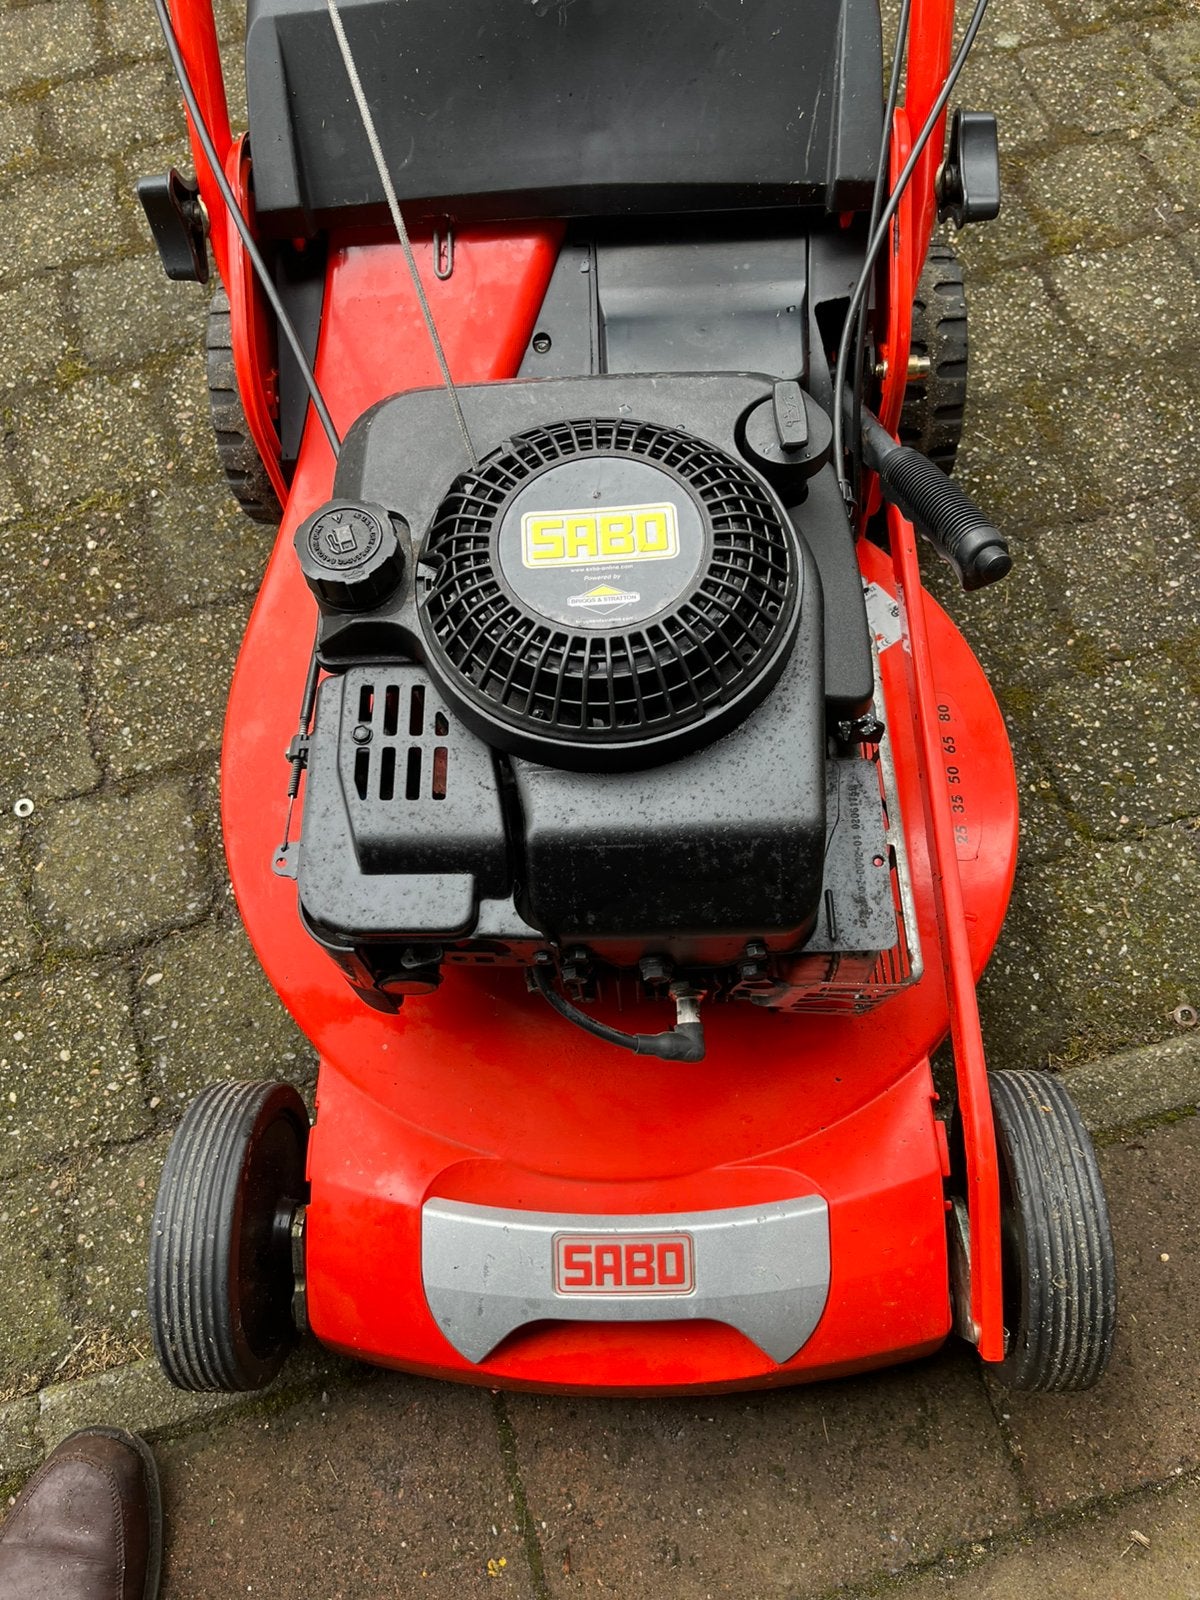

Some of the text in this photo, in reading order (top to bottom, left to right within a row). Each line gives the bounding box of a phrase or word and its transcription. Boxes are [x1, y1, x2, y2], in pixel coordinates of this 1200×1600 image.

[531, 512, 669, 559] SABO
[603, 595, 637, 603] STRATTON
[937, 705, 969, 843] 25 35 50 65 80
[564, 1242, 685, 1286] SABO
